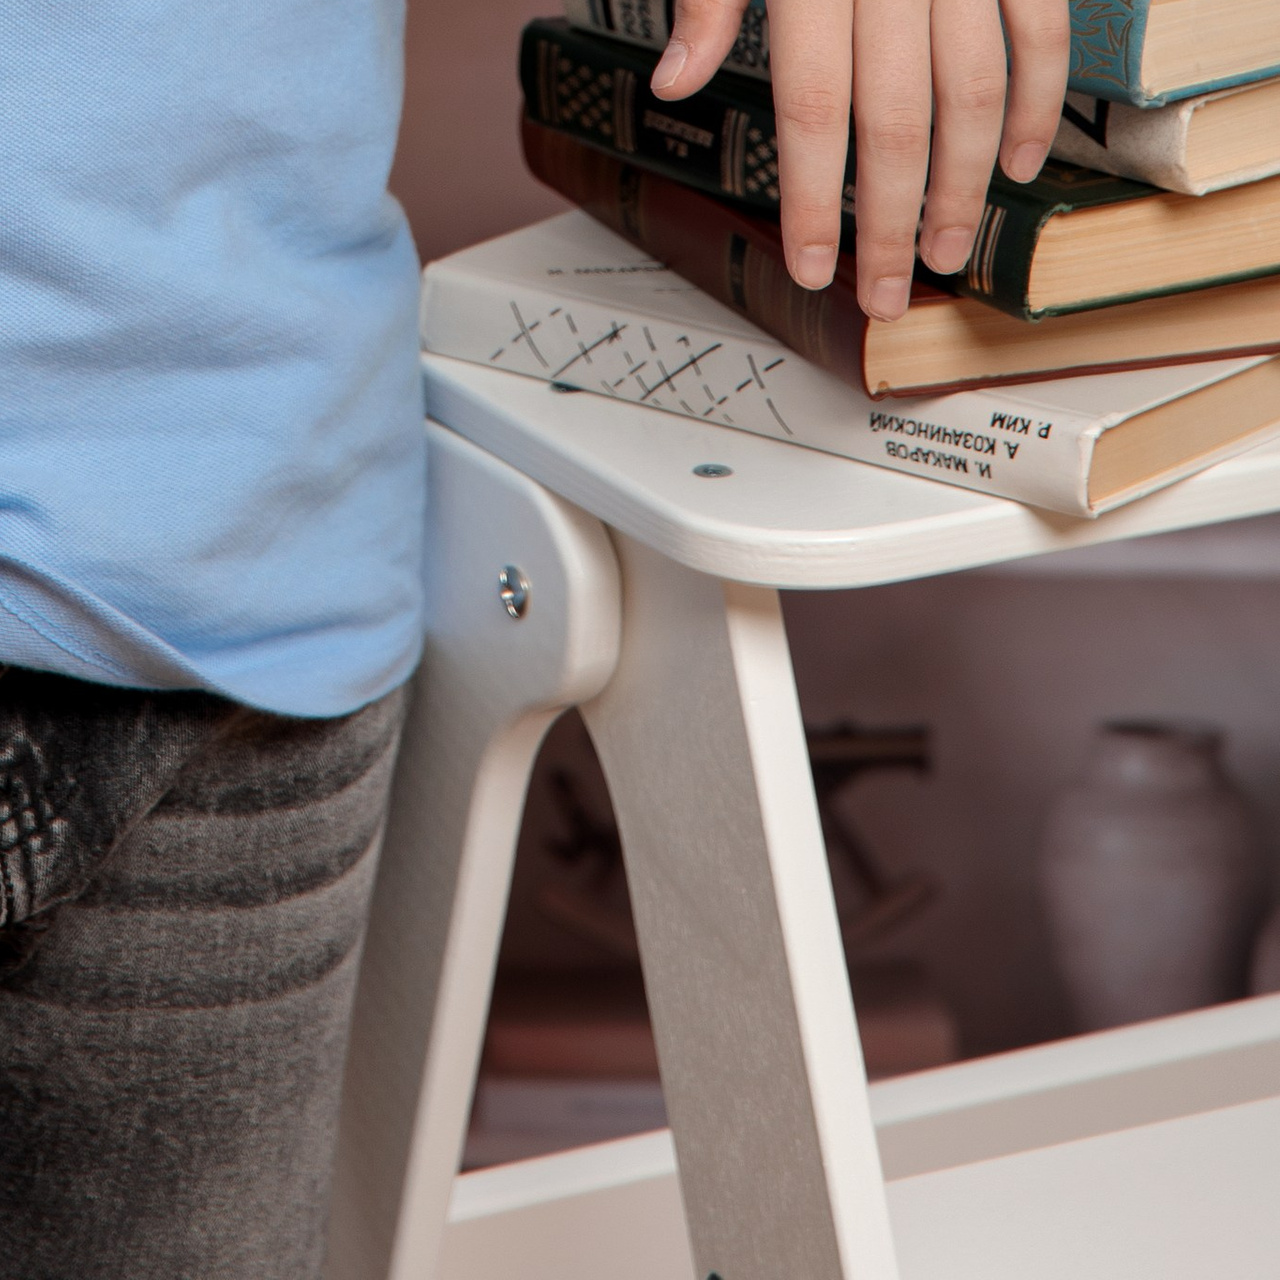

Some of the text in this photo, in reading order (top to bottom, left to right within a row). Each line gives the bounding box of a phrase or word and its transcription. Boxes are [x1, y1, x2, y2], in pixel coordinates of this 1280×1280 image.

[869, 412, 1020, 459] А. КОЗАЧИНСКИЙ
[990, 412, 1053, 439] Р. КИМ
[885, 440, 993, 479] И. МАКАРОВ
